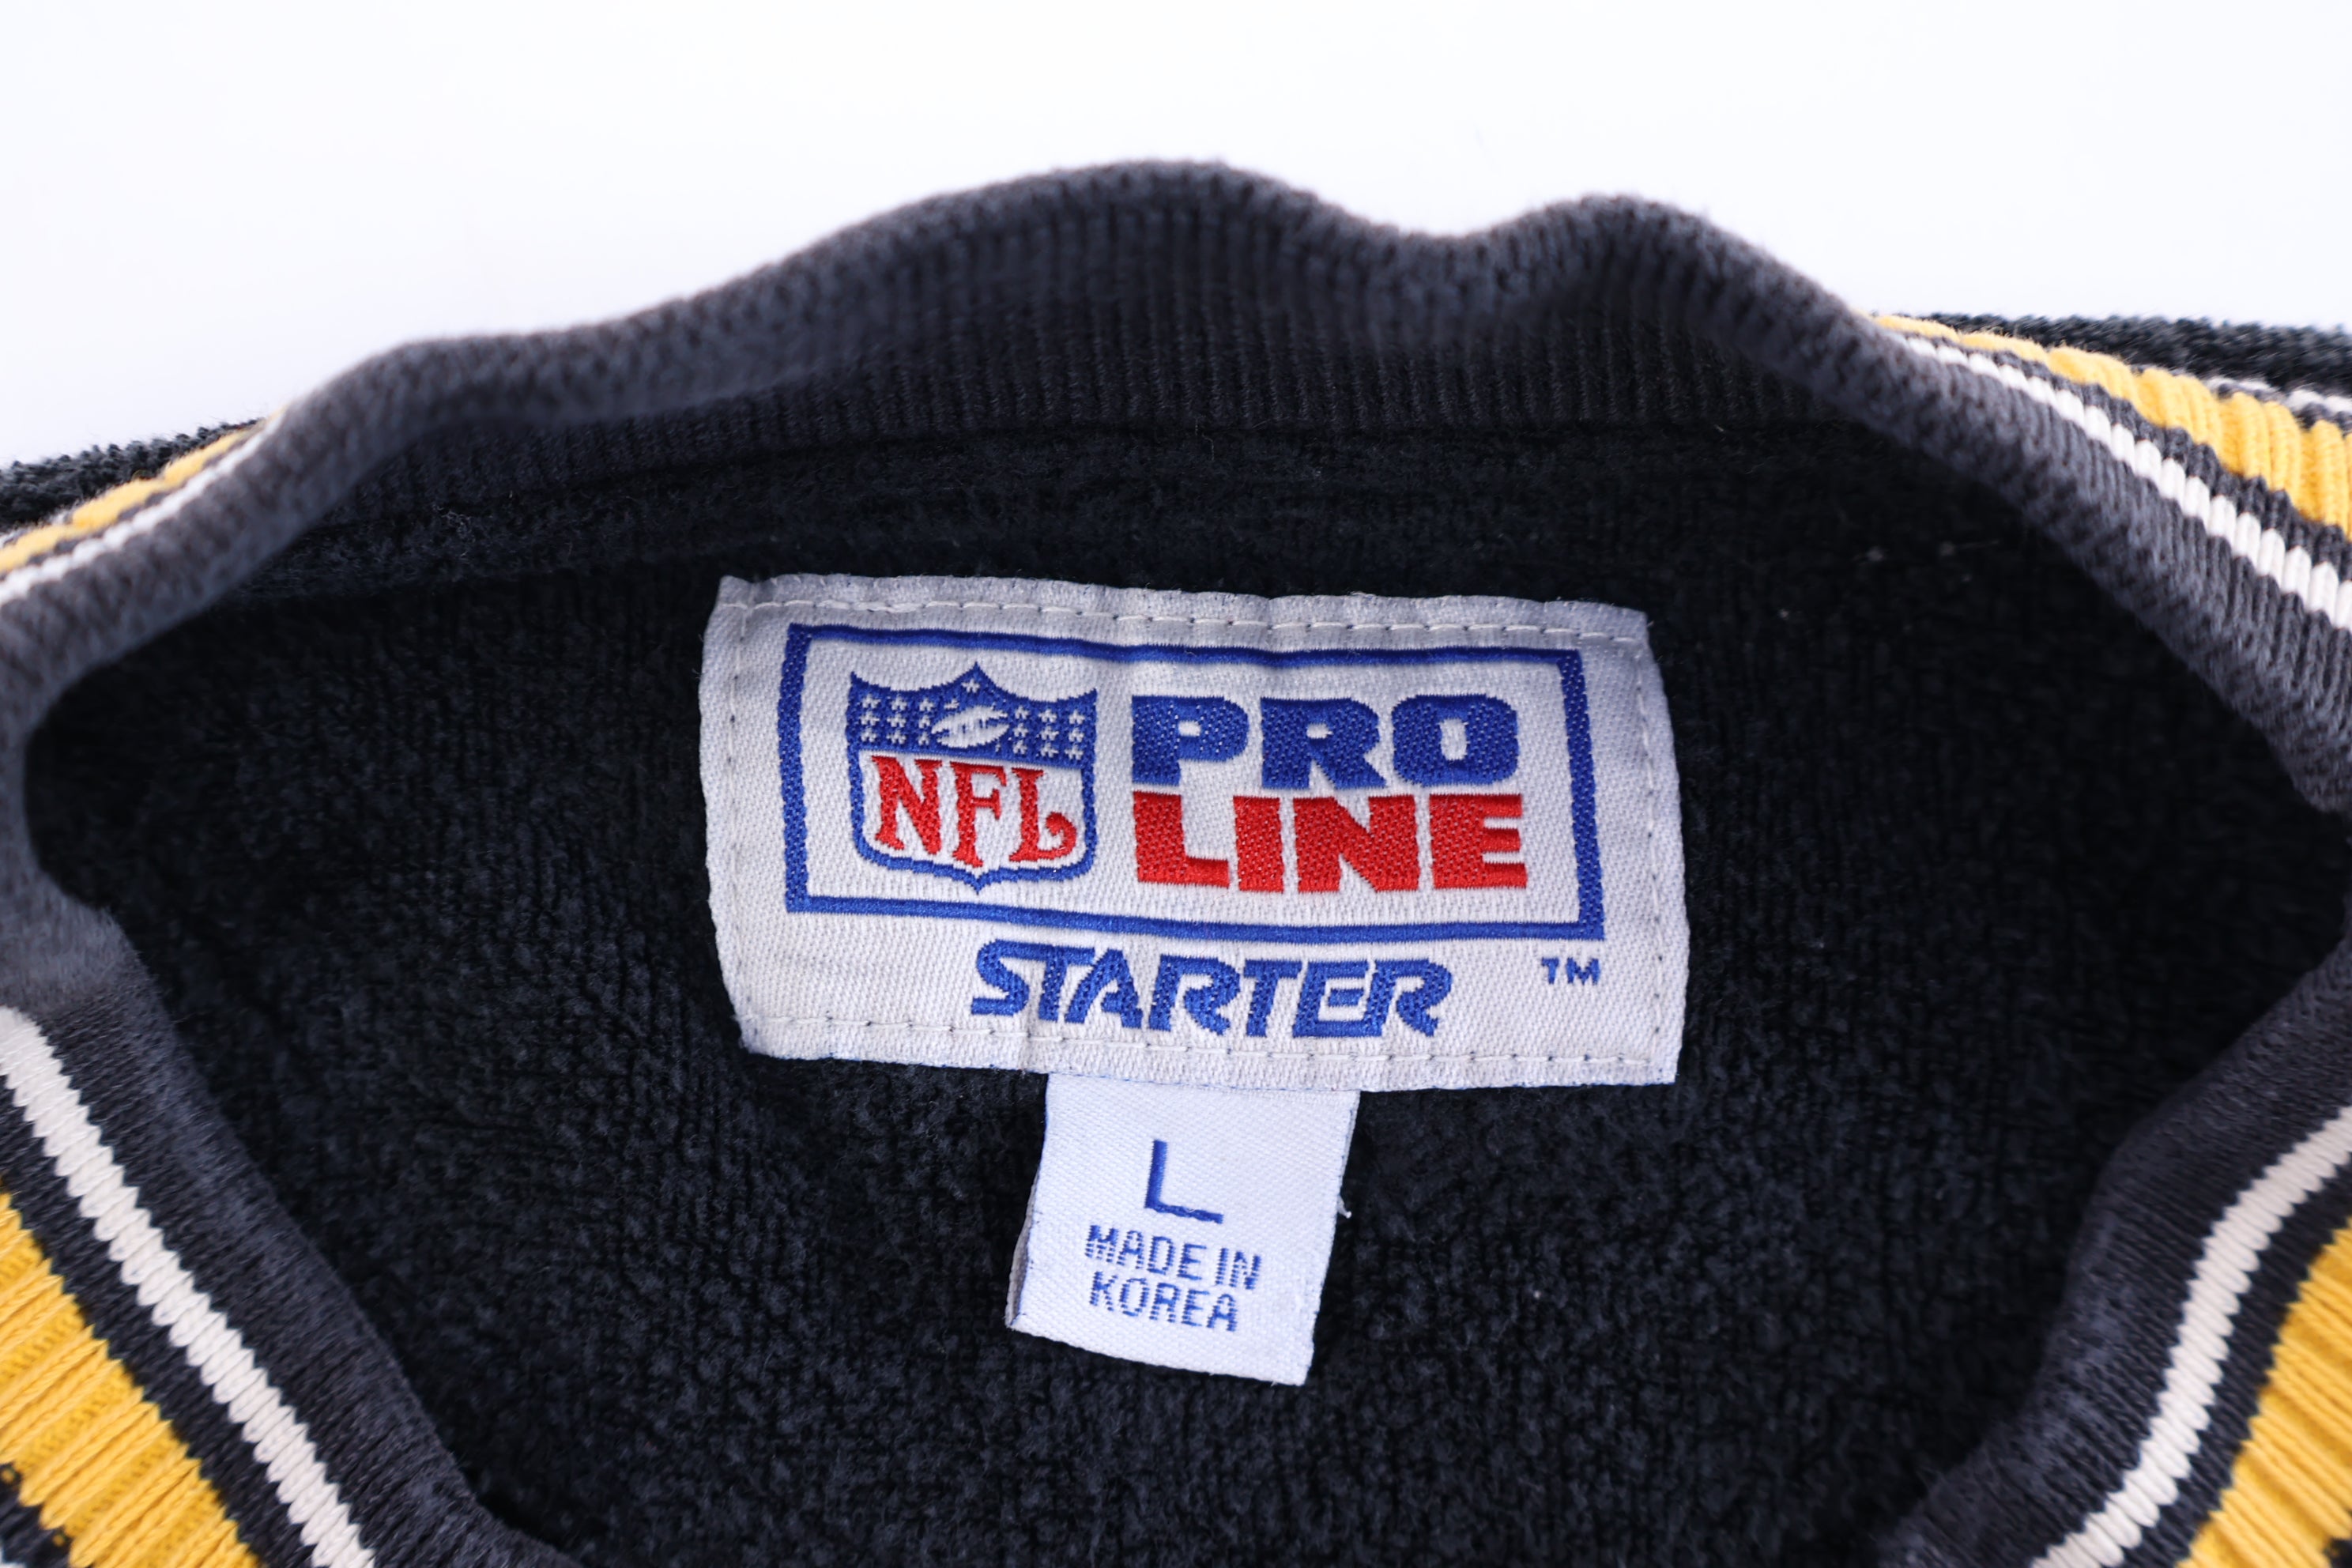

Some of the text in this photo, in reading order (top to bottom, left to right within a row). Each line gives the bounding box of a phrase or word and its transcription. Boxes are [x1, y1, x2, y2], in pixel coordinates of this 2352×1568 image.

[1132, 693, 1519, 790] PRO
[869, 754, 1078, 869] NFL
[1133, 792, 1528, 893] LINE
[971, 940, 1453, 1038] STARTER
[1144, 1139, 1223, 1224] L
[1084, 1224, 1262, 1290] MADE IN
[1088, 1270, 1238, 1332] KOREA
